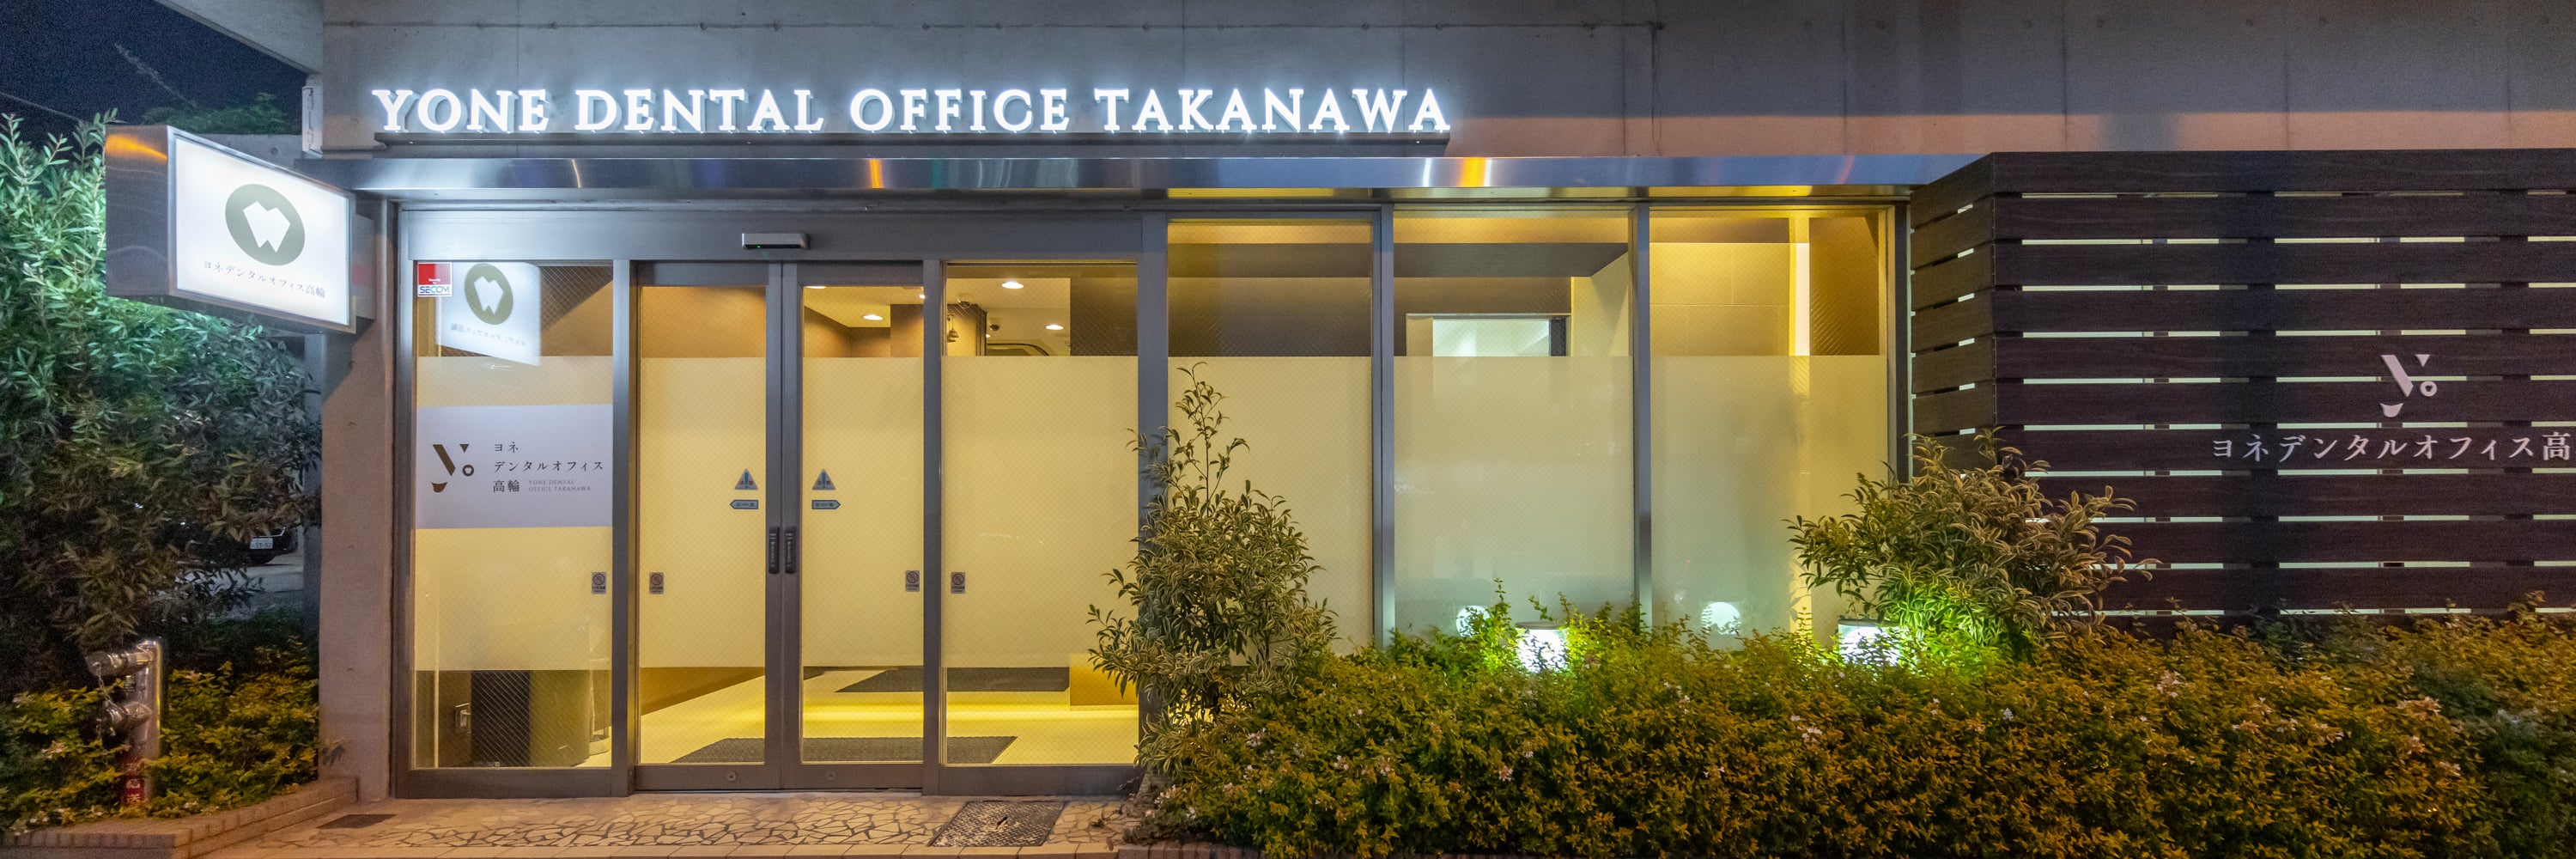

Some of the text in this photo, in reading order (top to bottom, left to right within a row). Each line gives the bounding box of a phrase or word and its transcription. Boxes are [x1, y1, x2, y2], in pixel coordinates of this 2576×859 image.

[372, 88, 1451, 132] YONE DENTAL OFFICE TAKANAWA
[203, 260, 326, 298] ヨネデンタルオフィス高輪
[419, 285, 450, 294] SECOM
[494, 441, 519, 454] ヨネ
[494, 460, 604, 472] デンタルオフィス
[493, 479, 519, 493] 高輪
